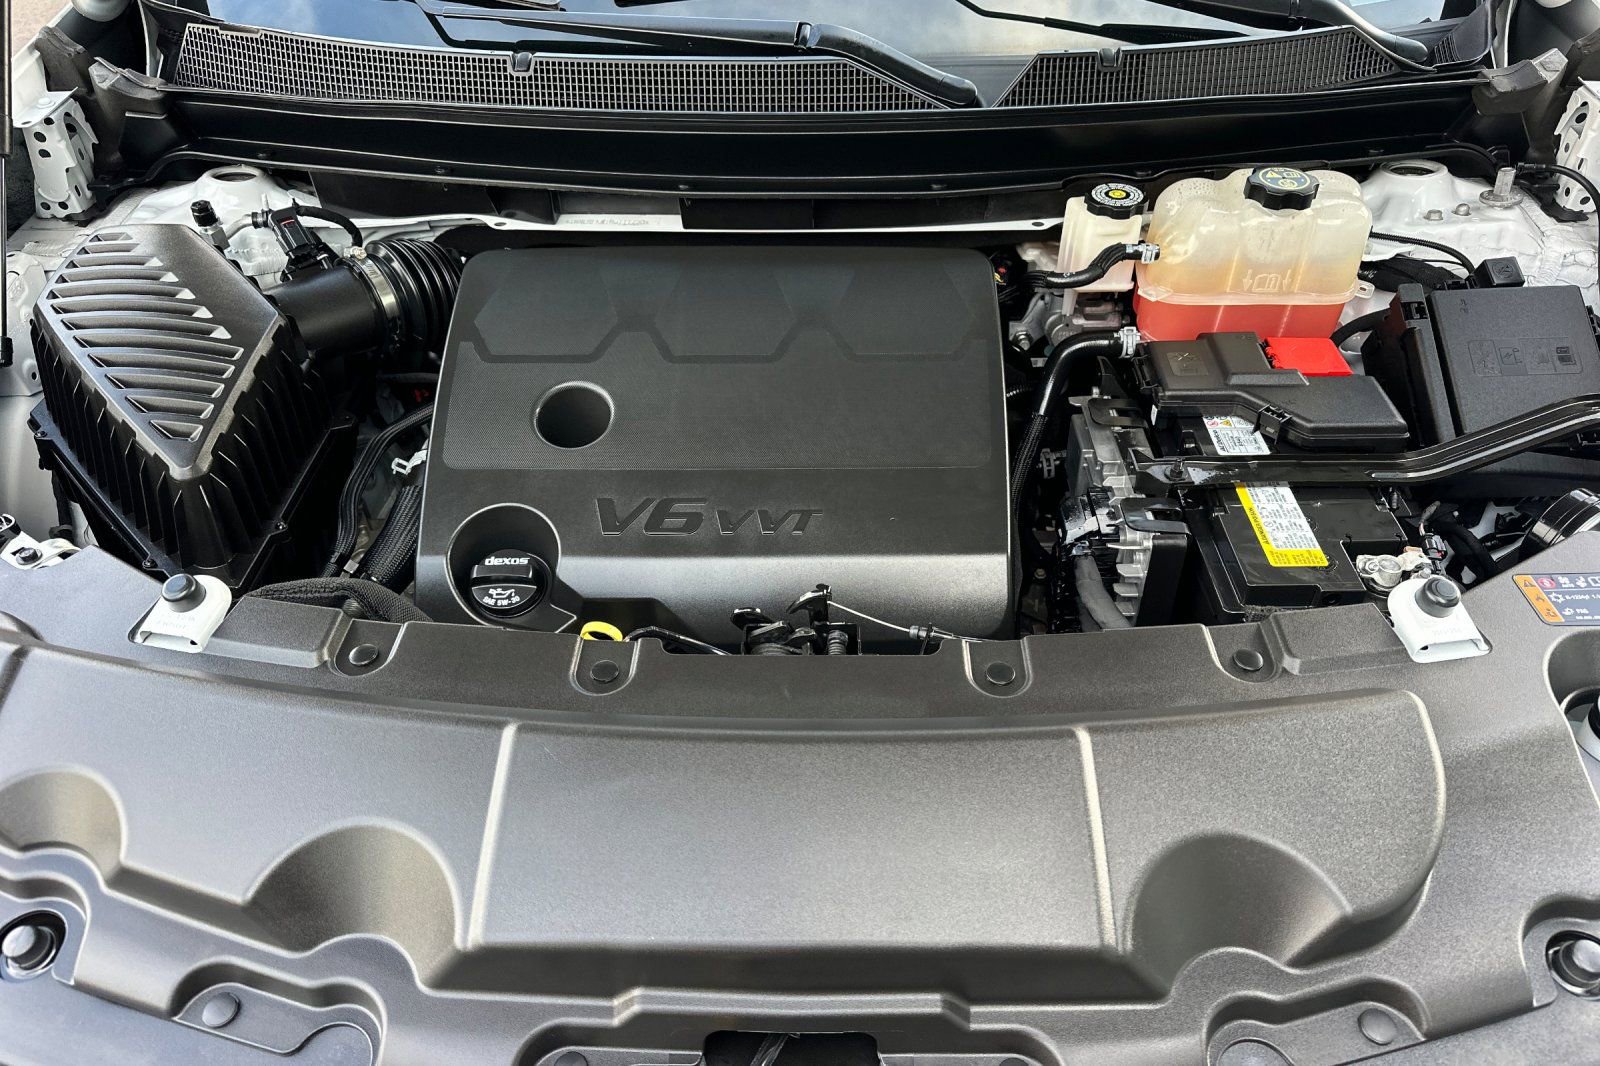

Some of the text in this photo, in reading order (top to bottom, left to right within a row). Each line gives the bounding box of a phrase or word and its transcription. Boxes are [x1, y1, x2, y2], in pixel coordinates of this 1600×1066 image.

[595, 497, 824, 536] V6 VVT
[484, 556, 531, 566] dexos
[482, 595, 521, 606] SAE 5W-30
